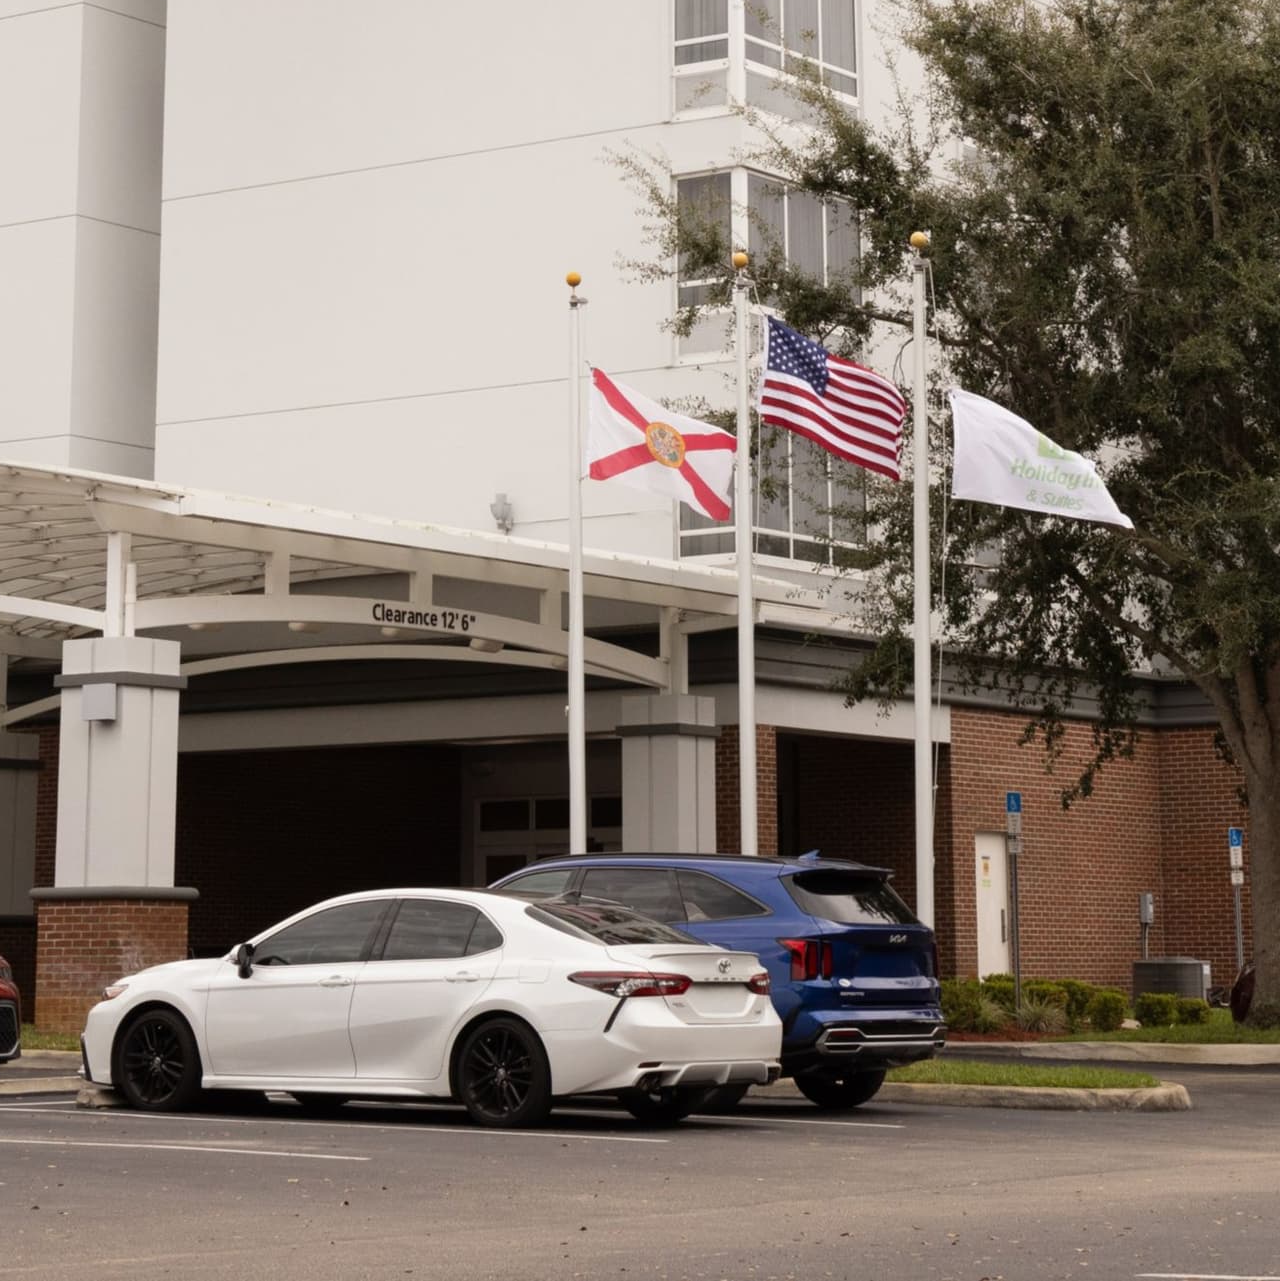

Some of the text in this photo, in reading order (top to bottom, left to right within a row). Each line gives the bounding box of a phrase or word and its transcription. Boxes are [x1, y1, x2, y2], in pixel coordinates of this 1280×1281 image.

[1010, 459, 1080, 489] Holiday
[372, 603, 476, 631] Clearance 12' 6"
